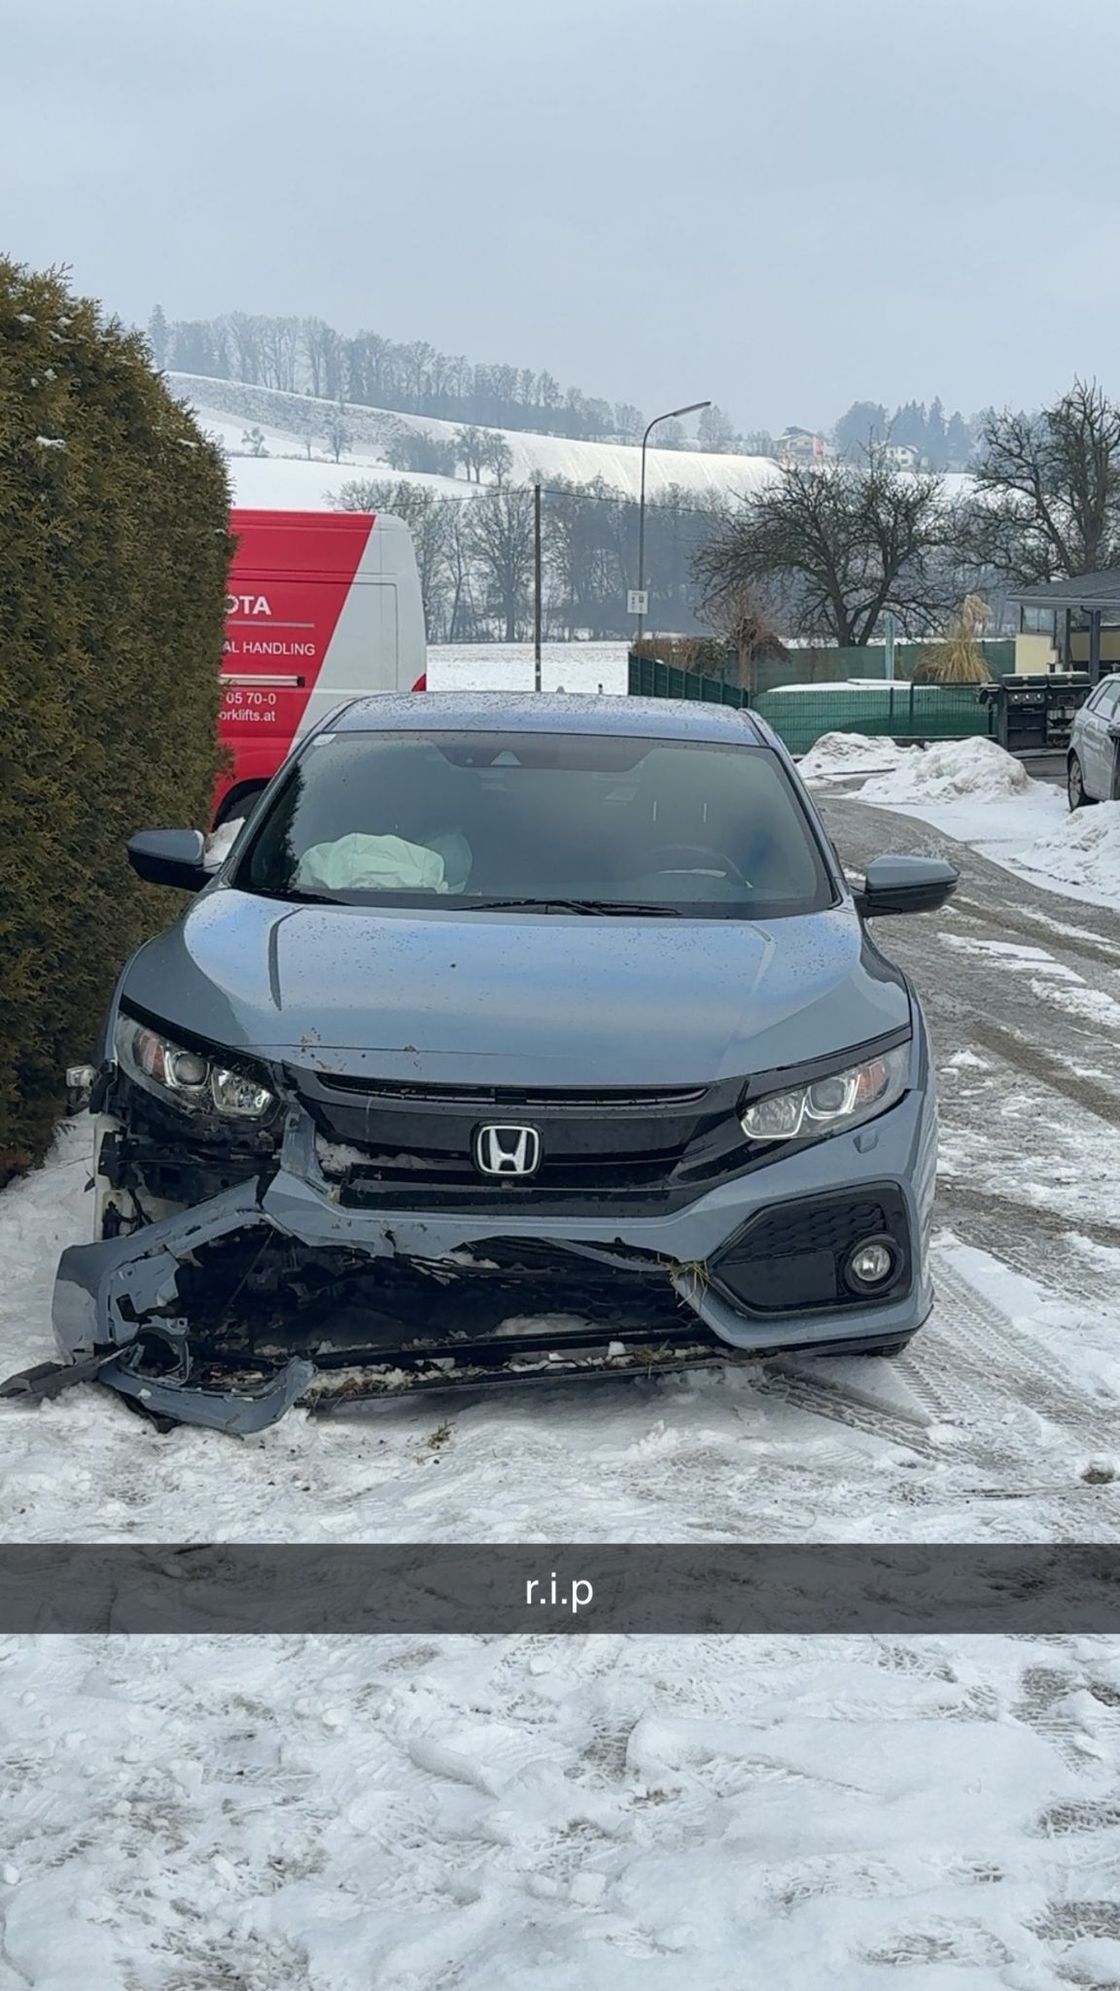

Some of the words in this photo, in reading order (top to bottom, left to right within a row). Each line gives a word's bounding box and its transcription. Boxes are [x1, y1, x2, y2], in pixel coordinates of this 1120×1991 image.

[242, 641, 316, 656] HANDLING
[225, 692, 243, 704] 05
[246, 692, 277, 705] 70-0
